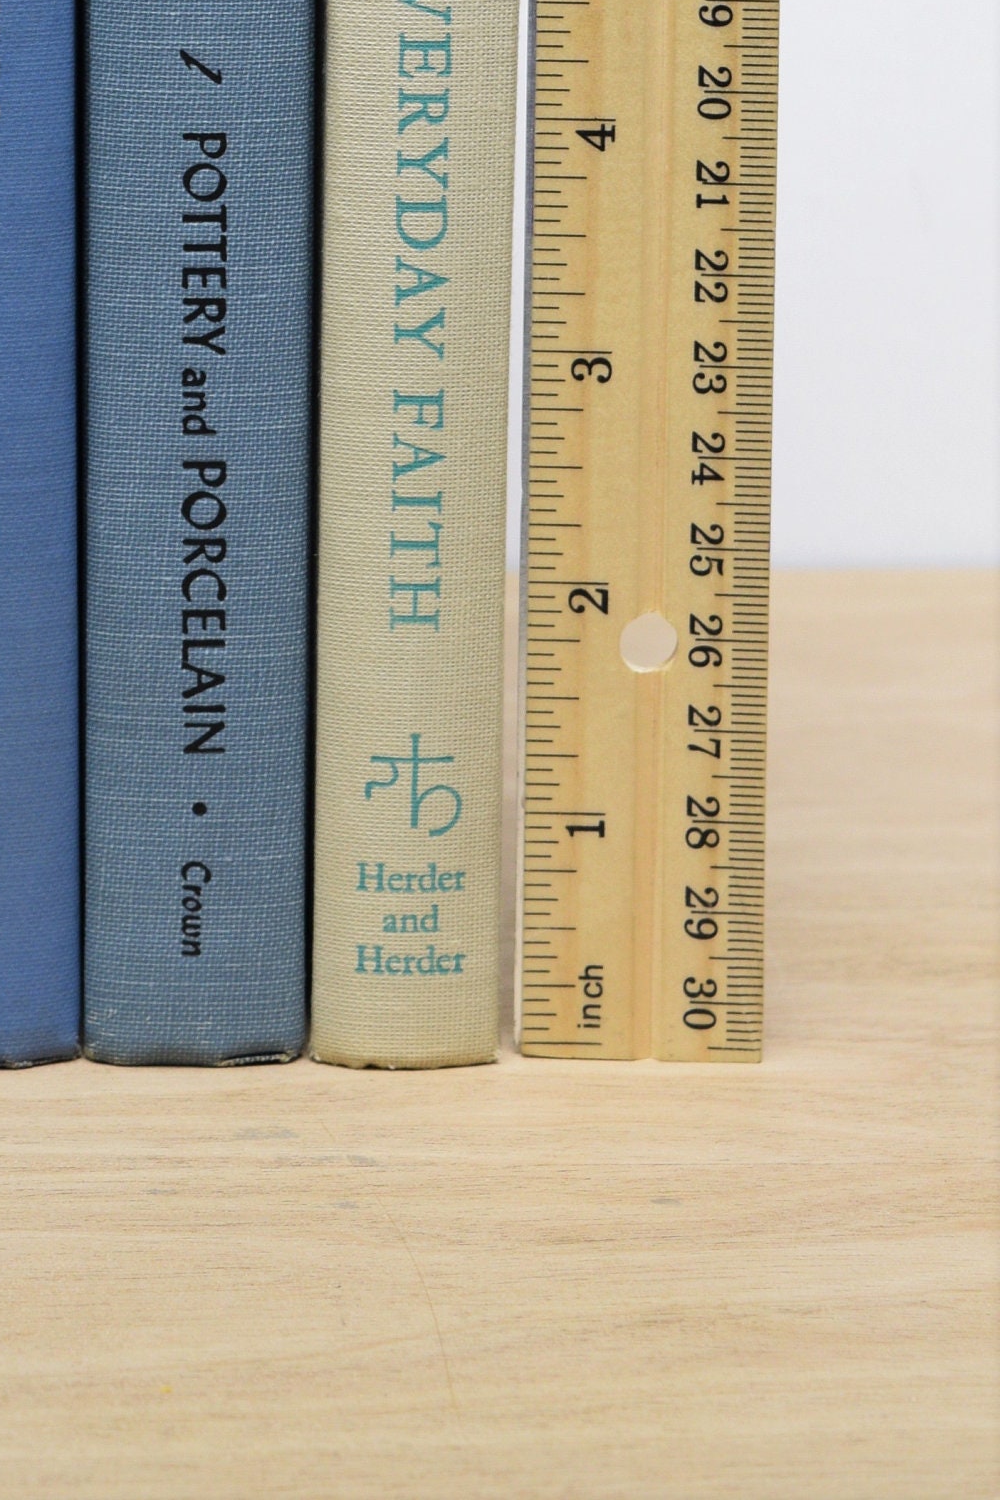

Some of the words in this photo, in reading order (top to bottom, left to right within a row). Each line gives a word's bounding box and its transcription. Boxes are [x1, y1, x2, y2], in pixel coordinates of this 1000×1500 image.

[697, 66, 732, 120] 20
[575, 124, 616, 151] 4
[695, 160, 730, 208] 21
[182, 133, 227, 355] POTTERY
[694, 249, 729, 303] 22
[571, 356, 612, 383] 3
[692, 340, 727, 394] 23
[182, 368, 212, 435] and
[691, 431, 725, 485] 24
[390, 390, 446, 630] FAITH
[689, 523, 724, 577] 25
[181, 460, 227, 754] PORCELAIN
[568, 587, 609, 615] 2
[688, 613, 723, 668] 26
[687, 704, 722, 760] 27
[566, 820, 605, 838] 1
[685, 795, 720, 849] 28
[357, 863, 465, 892] Herder
[181, 861, 212, 956] Crown
[383, 904, 439, 933] and
[684, 886, 719, 940] 29
[355, 945, 465, 974] Herder
[577, 964, 604, 1029] inch
[683, 976, 718, 1030] 30
